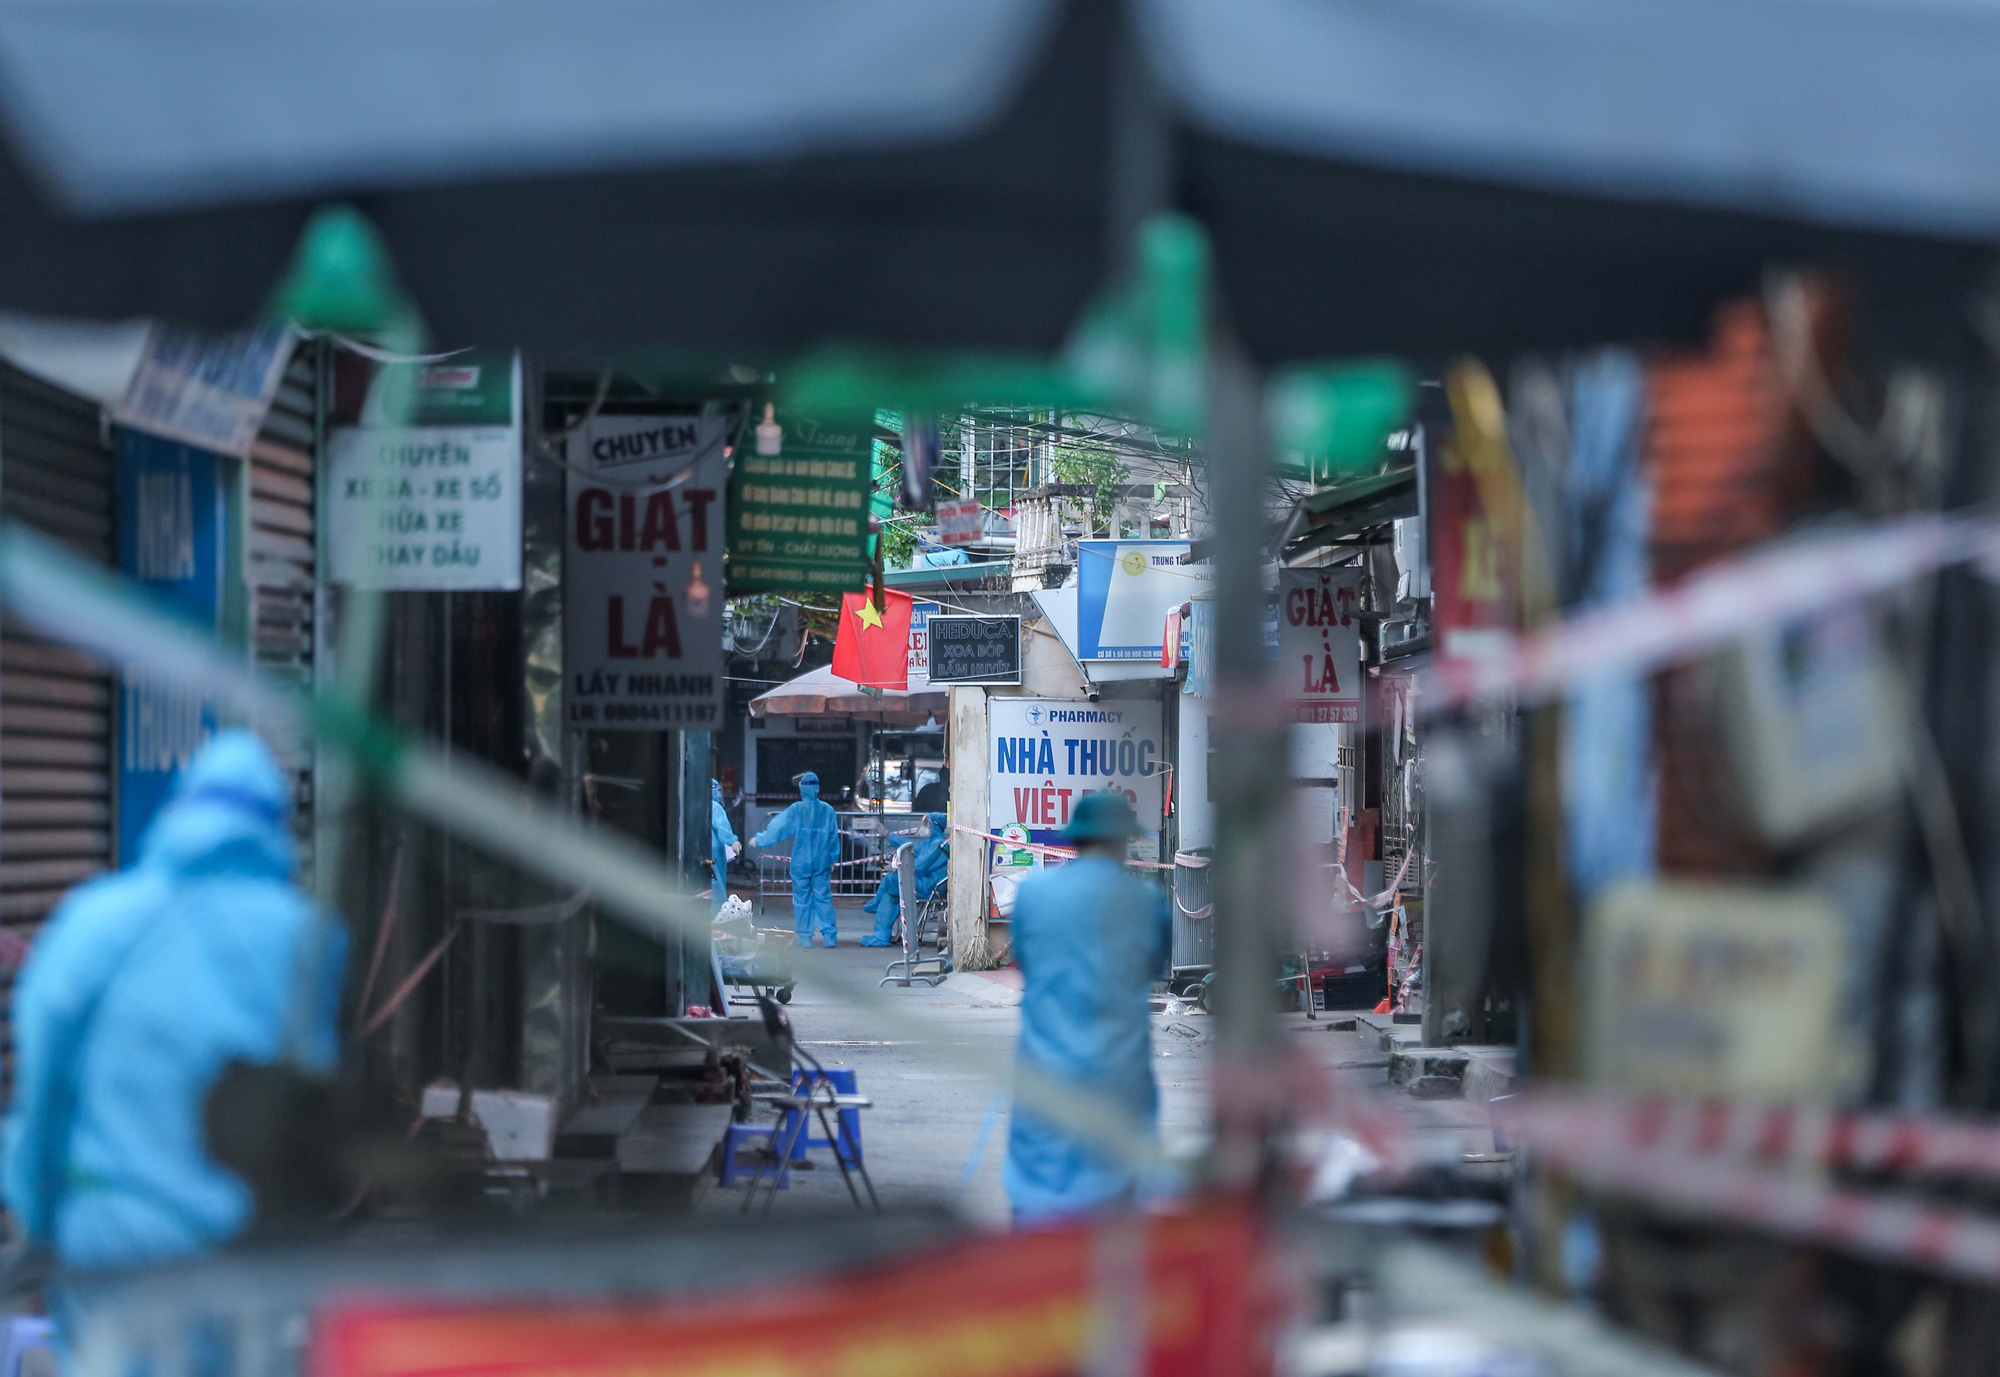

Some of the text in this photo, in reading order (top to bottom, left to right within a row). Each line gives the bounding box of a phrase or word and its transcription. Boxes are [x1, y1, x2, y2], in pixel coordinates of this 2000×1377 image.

[433, 478, 461, 500] XE
[434, 510, 463, 532] XE
[576, 474, 717, 567] GIẶT
[1152, 556, 1174, 566] TRUNG
[1286, 576, 1355, 638] GIẶT
[608, 580, 682, 658] LÀ
[943, 640, 1005, 658] XOA BÓP
[938, 658, 967, 676] BẤM
[971, 659, 1010, 678] HUYỆT
[1303, 642, 1341, 693] LÀ
[628, 674, 713, 697] NHANH
[1049, 710, 1123, 724] PHARMACY
[1317, 707, 1328, 721] 27
[1330, 707, 1341, 721] 57
[1342, 706, 1358, 721] 336
[998, 726, 1155, 777] NHÀ THUỐC
[1014, 780, 1073, 831] VIỆT
